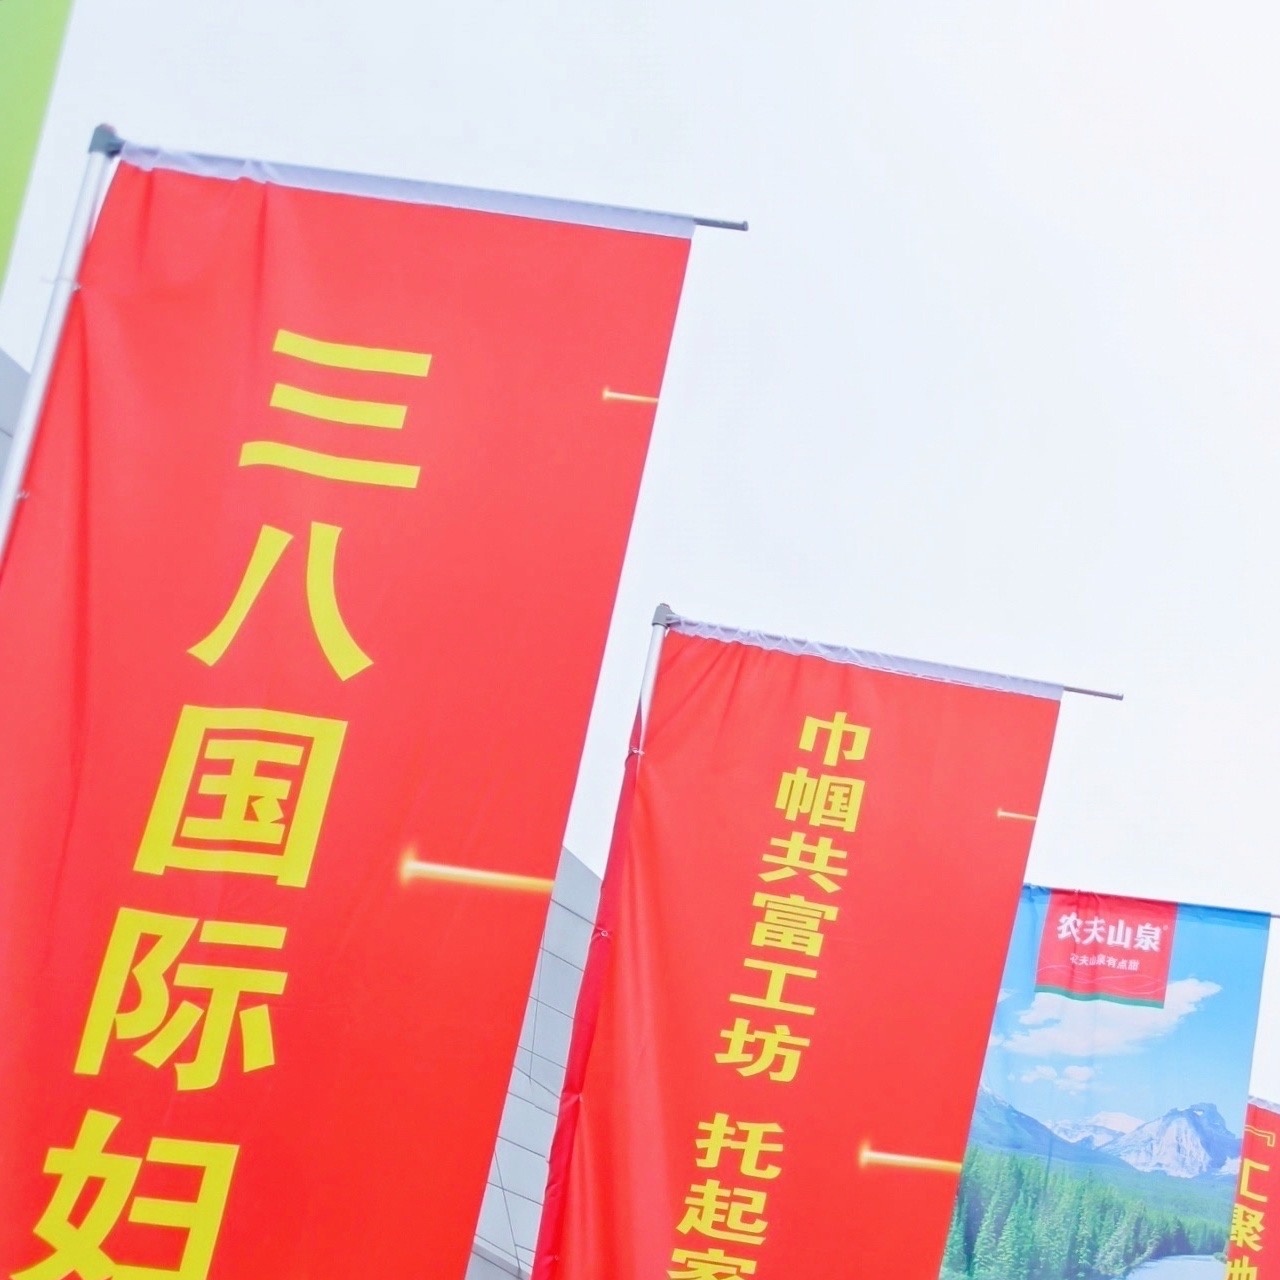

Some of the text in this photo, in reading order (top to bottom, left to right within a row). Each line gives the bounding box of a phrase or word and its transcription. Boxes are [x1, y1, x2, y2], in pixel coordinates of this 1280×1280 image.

[715, 711, 872, 1083] 巾帼共富工坊
[1056, 911, 1162, 952] 农夫山泉
